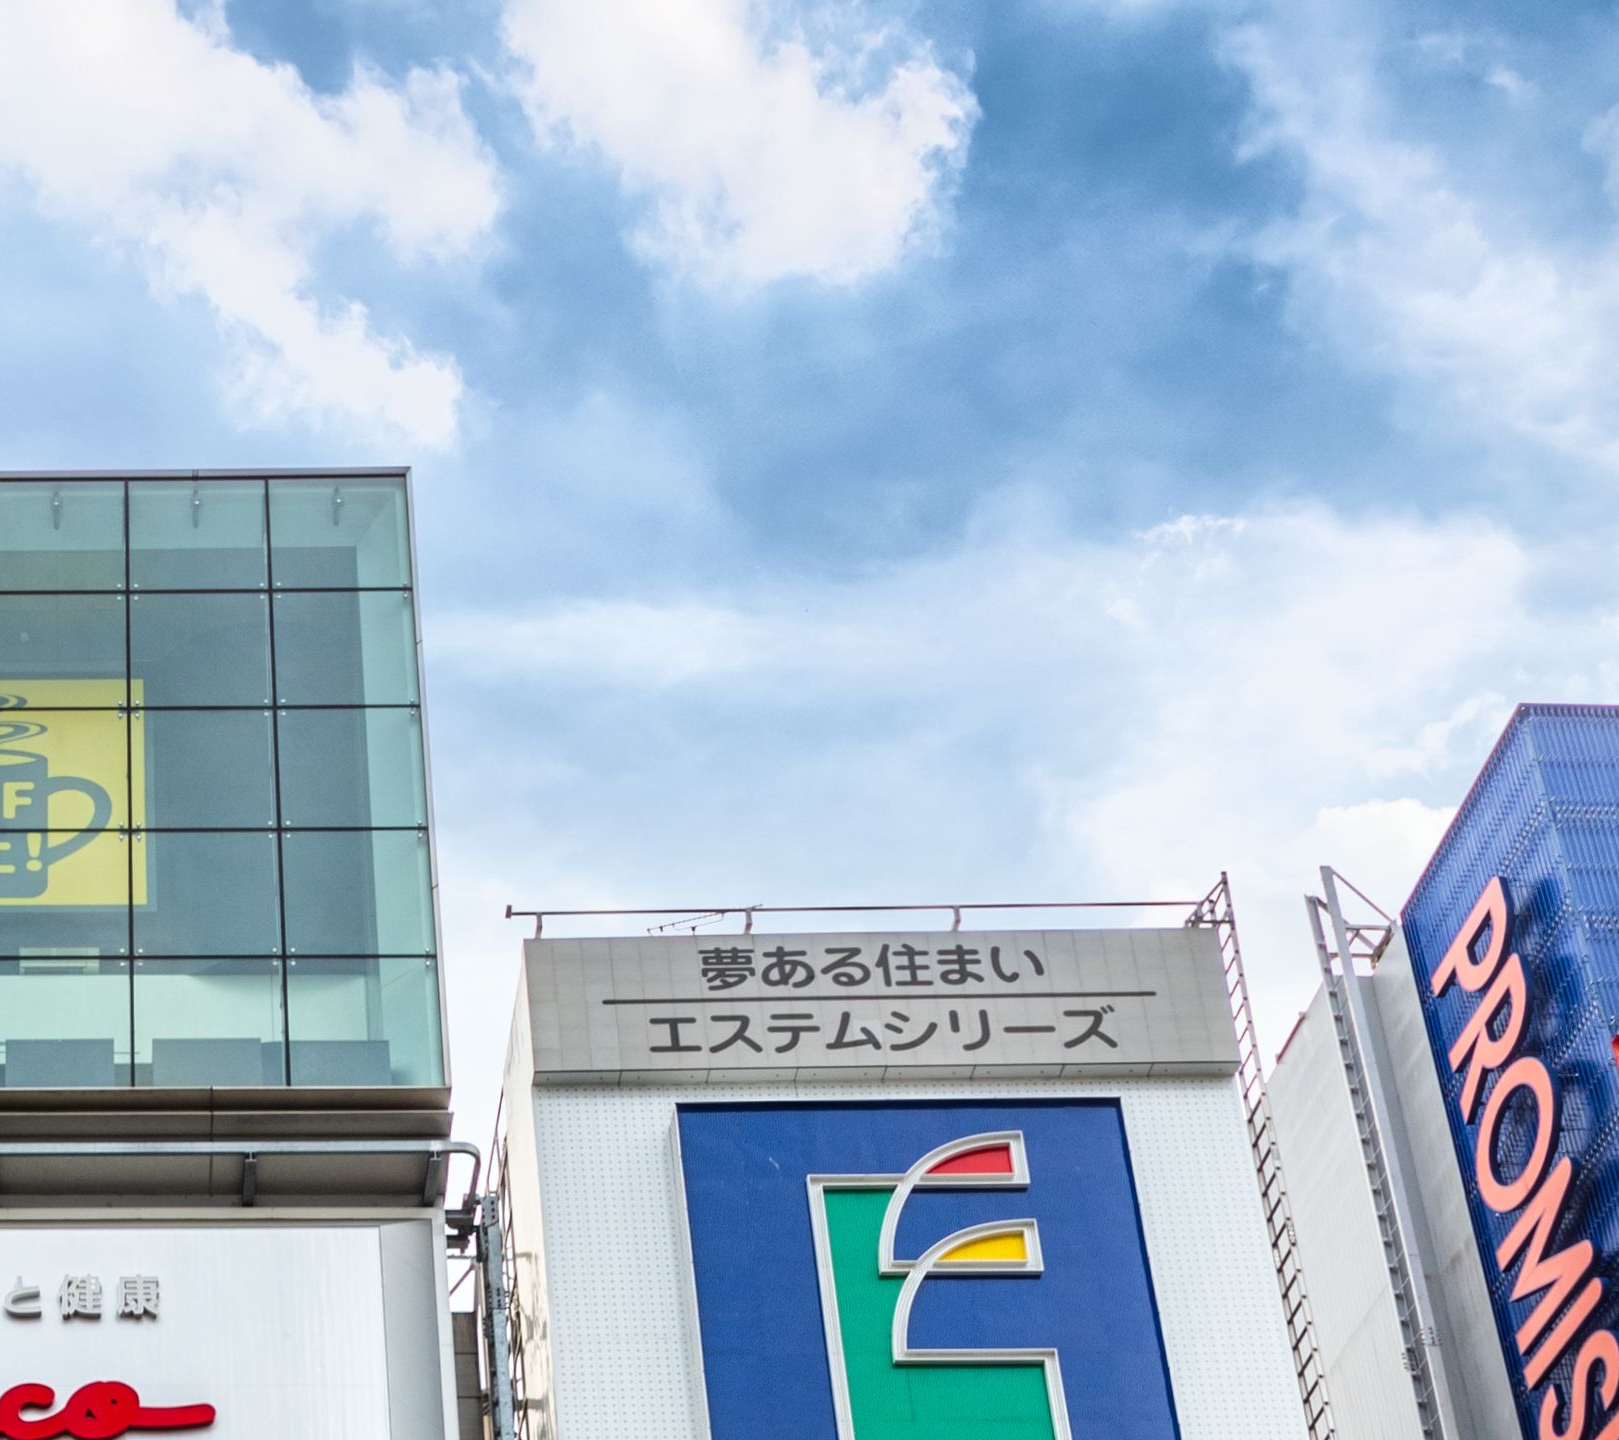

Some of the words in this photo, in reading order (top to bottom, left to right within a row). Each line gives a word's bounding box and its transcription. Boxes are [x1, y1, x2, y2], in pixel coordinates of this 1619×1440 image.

[699, 944, 1044, 990] 夢ある住まい
[648, 1005, 1119, 1054] エステムシリーズ
